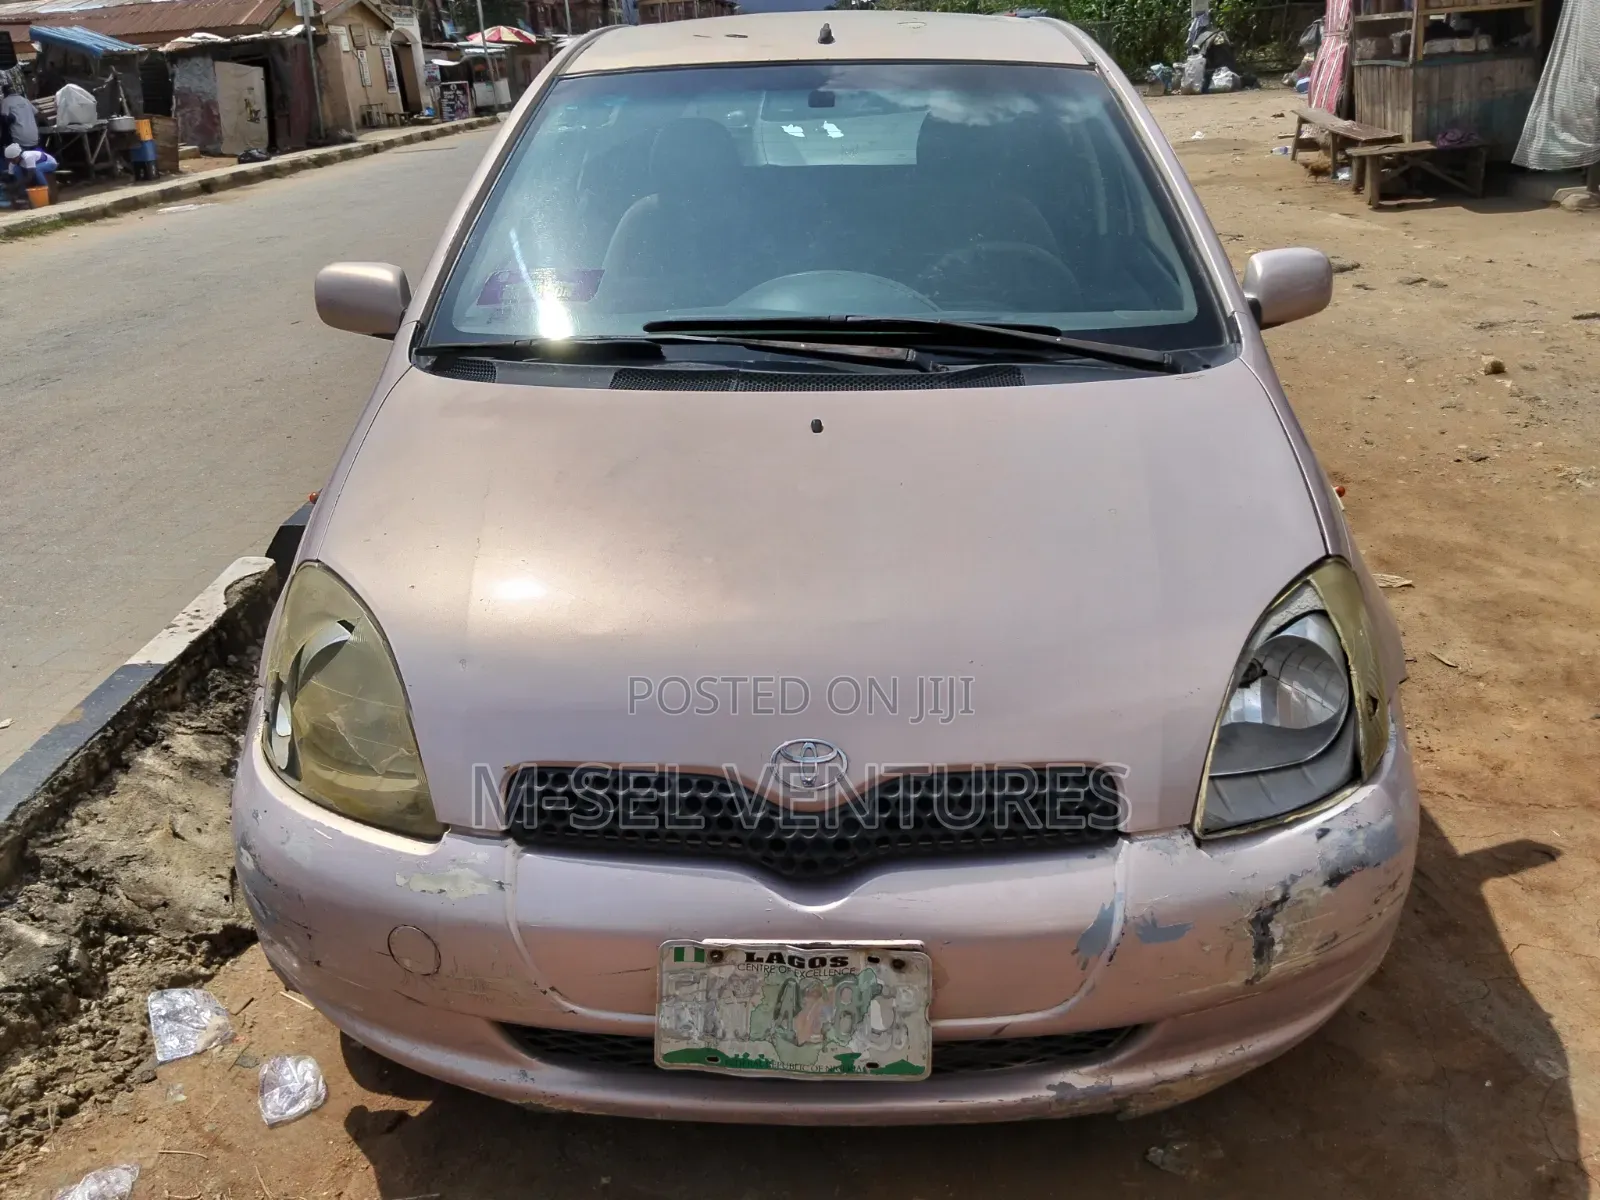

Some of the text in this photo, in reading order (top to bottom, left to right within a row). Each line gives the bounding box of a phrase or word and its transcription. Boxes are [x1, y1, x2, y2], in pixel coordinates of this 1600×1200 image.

[745, 952, 849, 969] LAGOS
[737, 963, 857, 978] CENTRE OF EXCELLENCE
